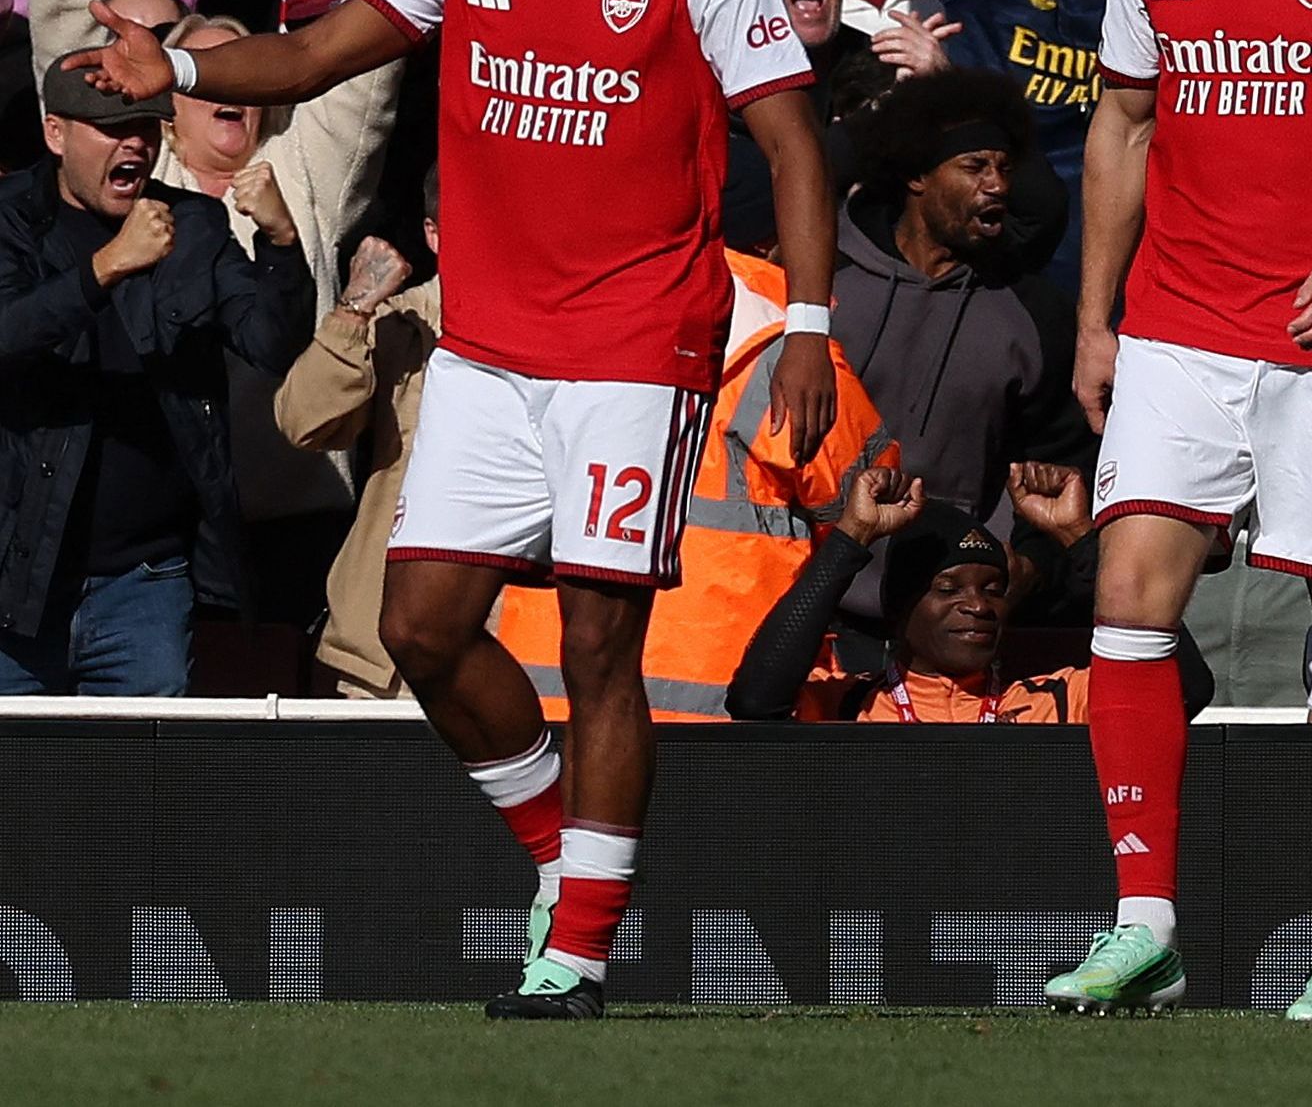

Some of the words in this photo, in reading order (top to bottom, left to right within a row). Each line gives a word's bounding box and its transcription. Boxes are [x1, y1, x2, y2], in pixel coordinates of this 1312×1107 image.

[470, 40, 641, 105] Emirates
[1024, 73, 1067, 105] FLY
[1175, 79, 1215, 115] FLY
[1218, 81, 1306, 117] BETTER
[481, 97, 517, 136] FLY
[516, 101, 608, 147] BETTER
[585, 462, 653, 545] 12
[1106, 785, 1143, 805] AFC
